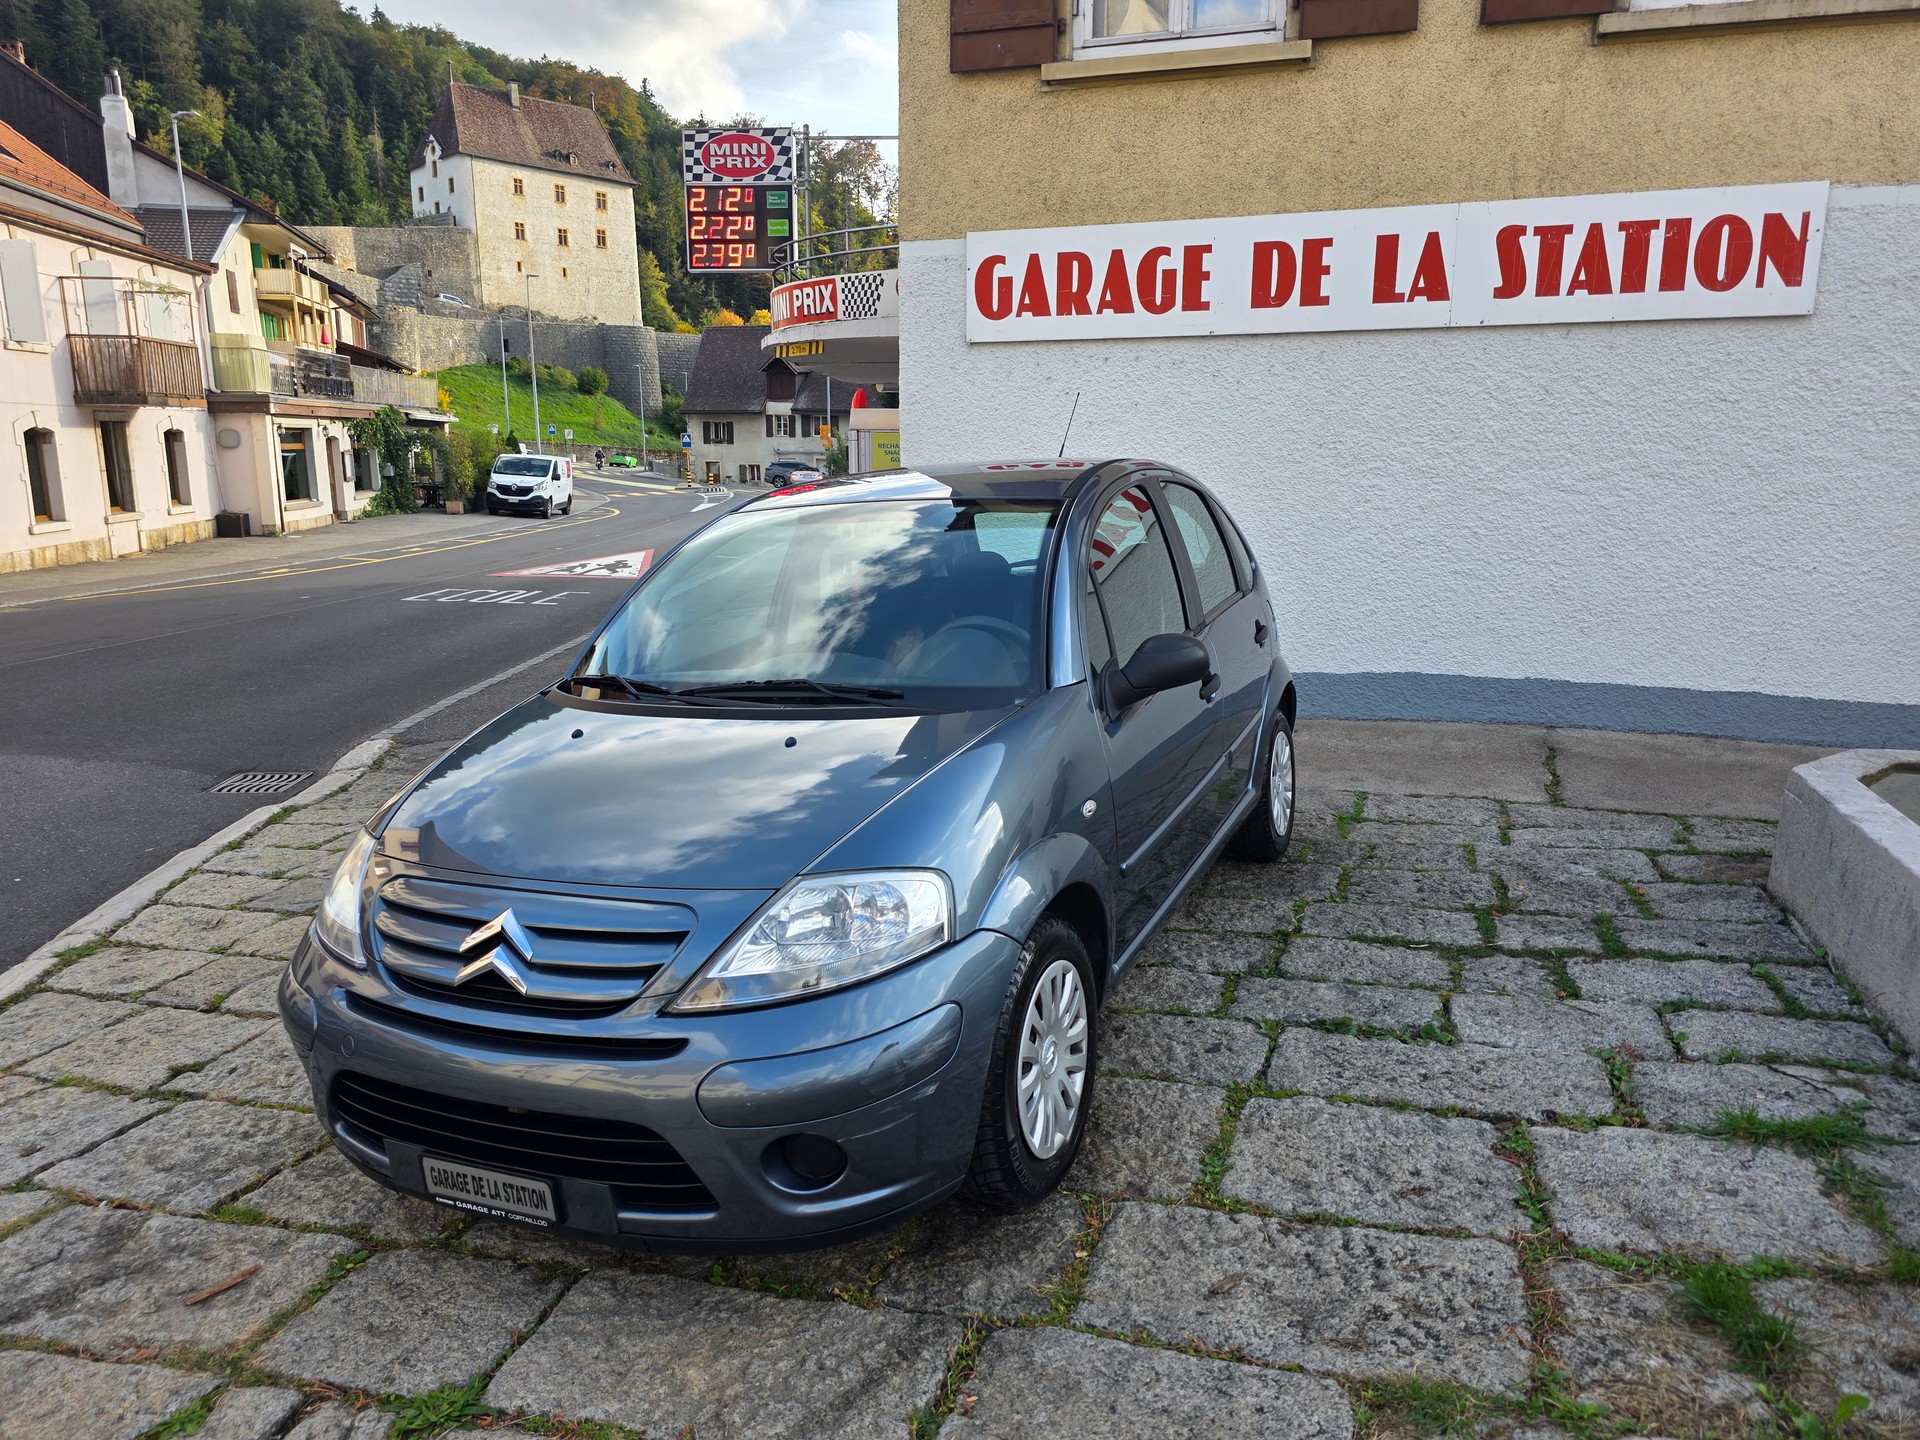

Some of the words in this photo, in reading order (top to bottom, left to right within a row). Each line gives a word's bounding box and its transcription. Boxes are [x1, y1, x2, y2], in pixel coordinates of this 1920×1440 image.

[709, 142, 767, 156] MINI
[709, 156, 767, 169] PRIX
[974, 244, 1213, 321] GARAGE
[1250, 237, 1334, 309] DE
[1371, 231, 1451, 304] LA
[1492, 211, 1811, 300] STATION
[772, 291, 790, 324] MINI
[793, 283, 835, 318] PRIX
[400, 588, 592, 606] ECOLE
[430, 1166, 471, 1195] GARAGE
[471, 1174, 487, 1198] DE
[486, 1178, 502, 1201] LA
[502, 1181, 548, 1211] STATION
[456, 1201, 489, 1214] GARAGE
[491, 1209, 506, 1218] ATT
[507, 1213, 548, 1227] CORTAILLOD
